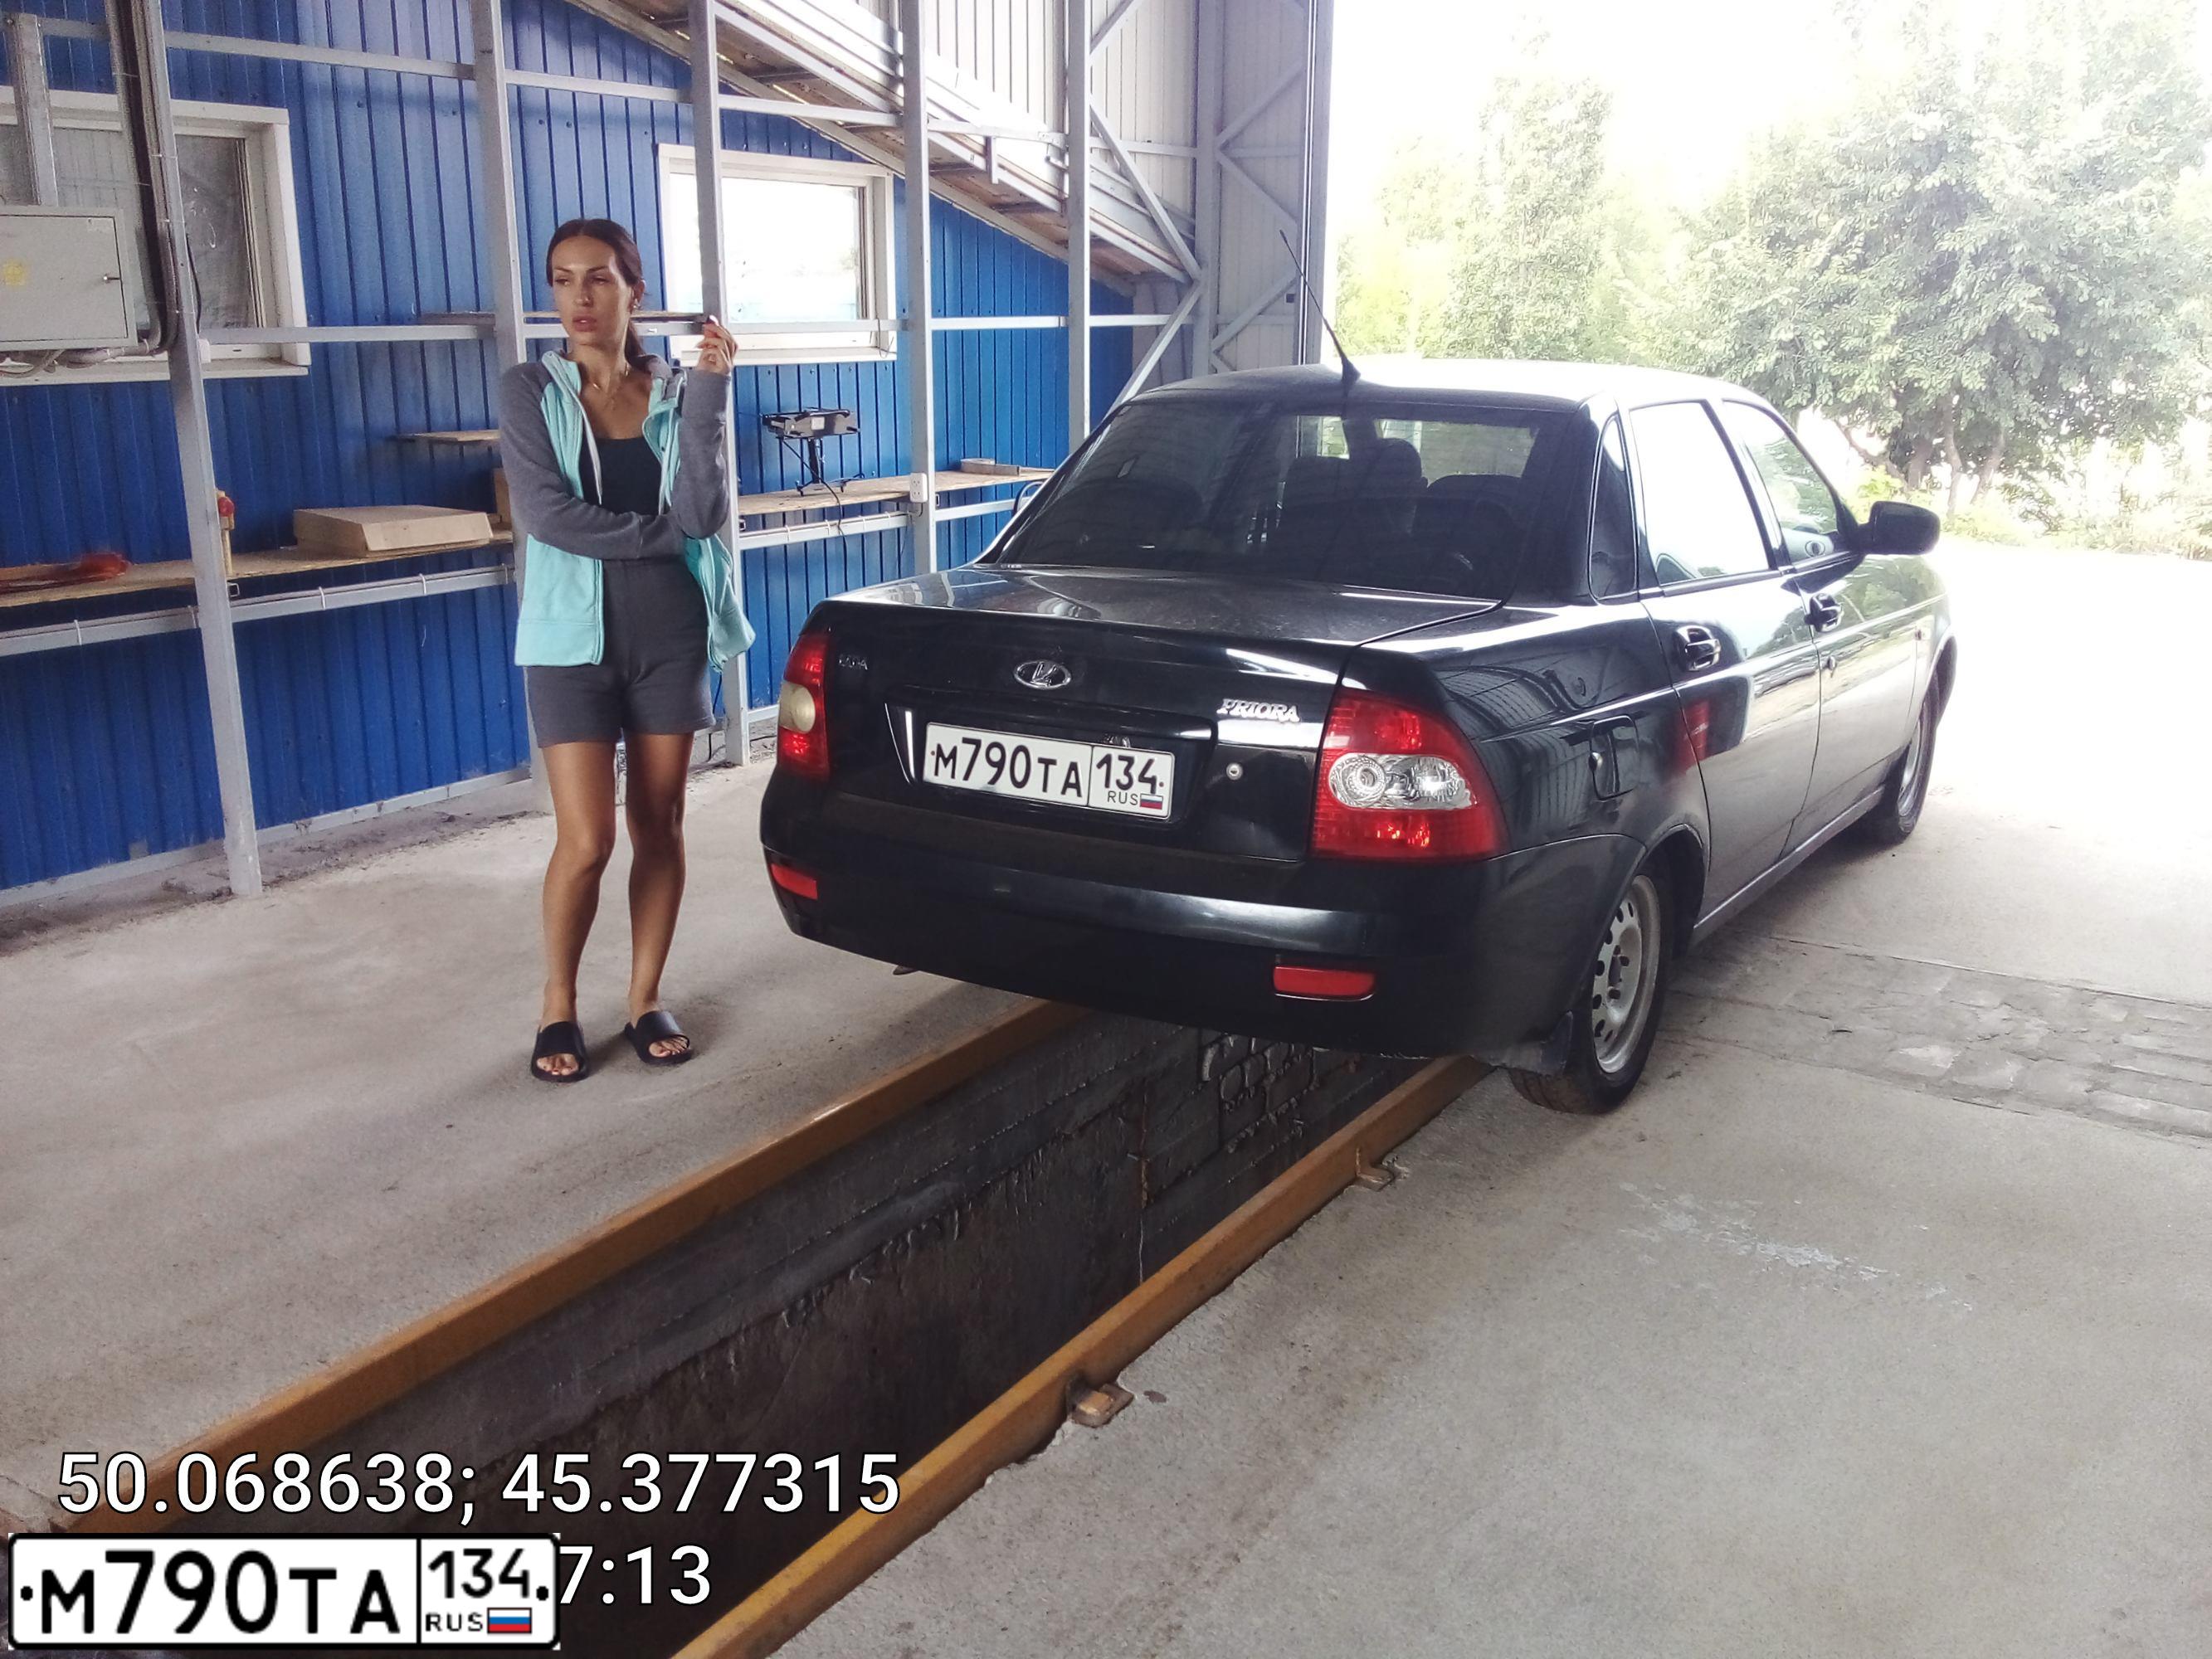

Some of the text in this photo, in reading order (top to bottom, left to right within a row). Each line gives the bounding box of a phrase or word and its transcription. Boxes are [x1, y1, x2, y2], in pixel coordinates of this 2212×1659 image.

[1216, 698, 1300, 722] PRIORA
[1095, 753, 1157, 795] 134
[1107, 790, 1138, 805] RUS
